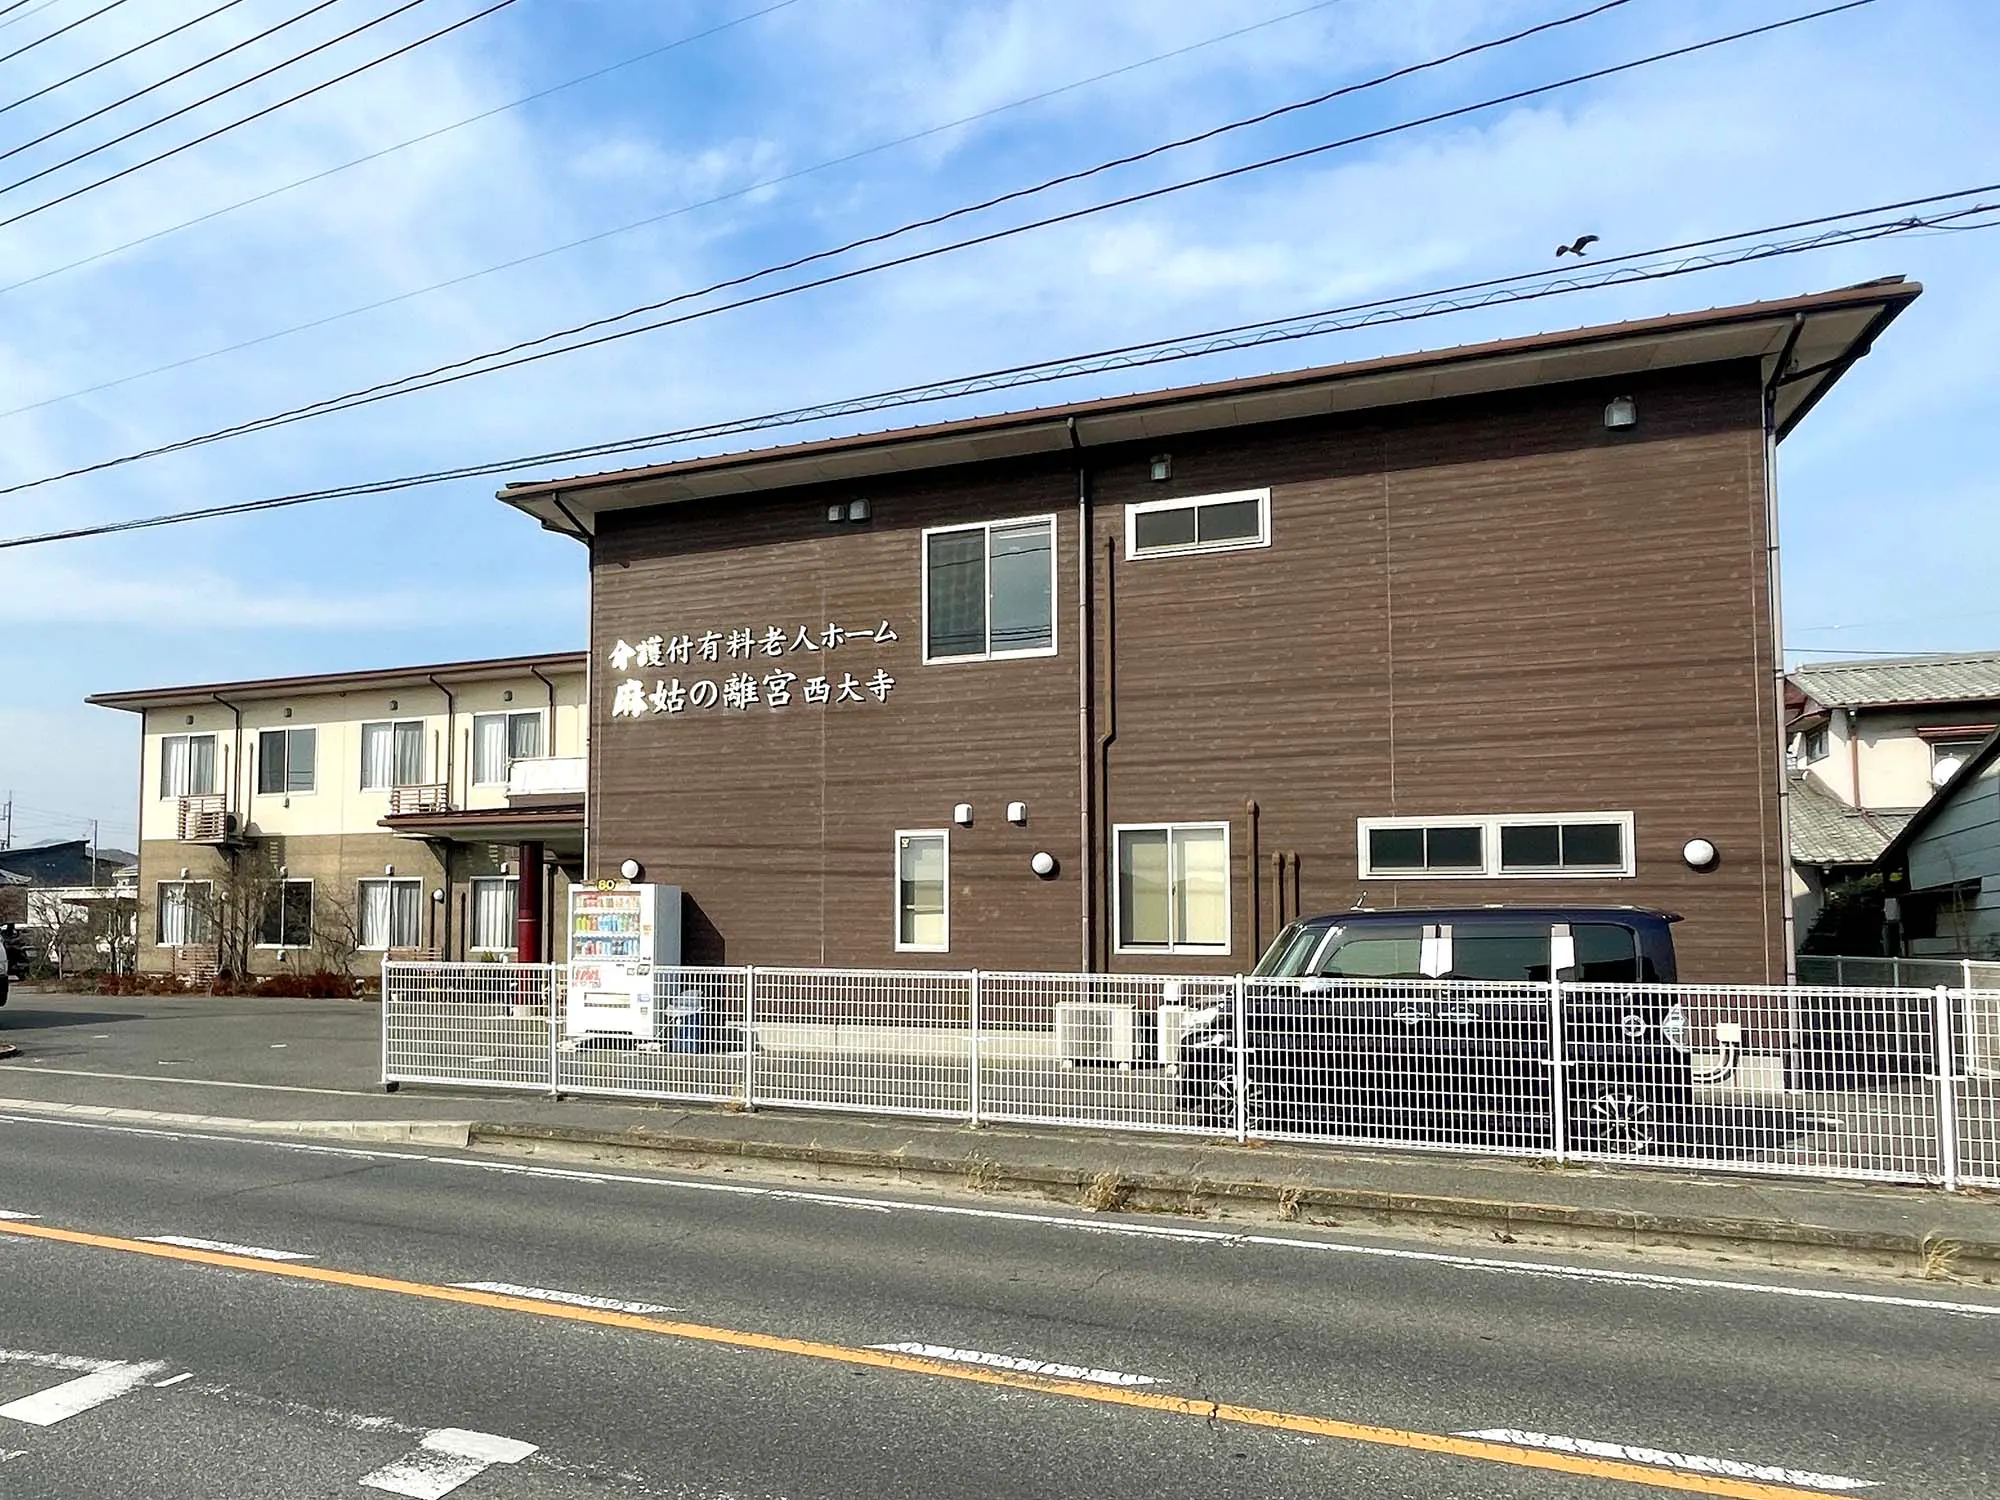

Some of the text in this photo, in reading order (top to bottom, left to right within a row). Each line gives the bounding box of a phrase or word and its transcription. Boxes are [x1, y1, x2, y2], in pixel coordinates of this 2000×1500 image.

[608, 620, 899, 671] 介護付有料老人ホーム
